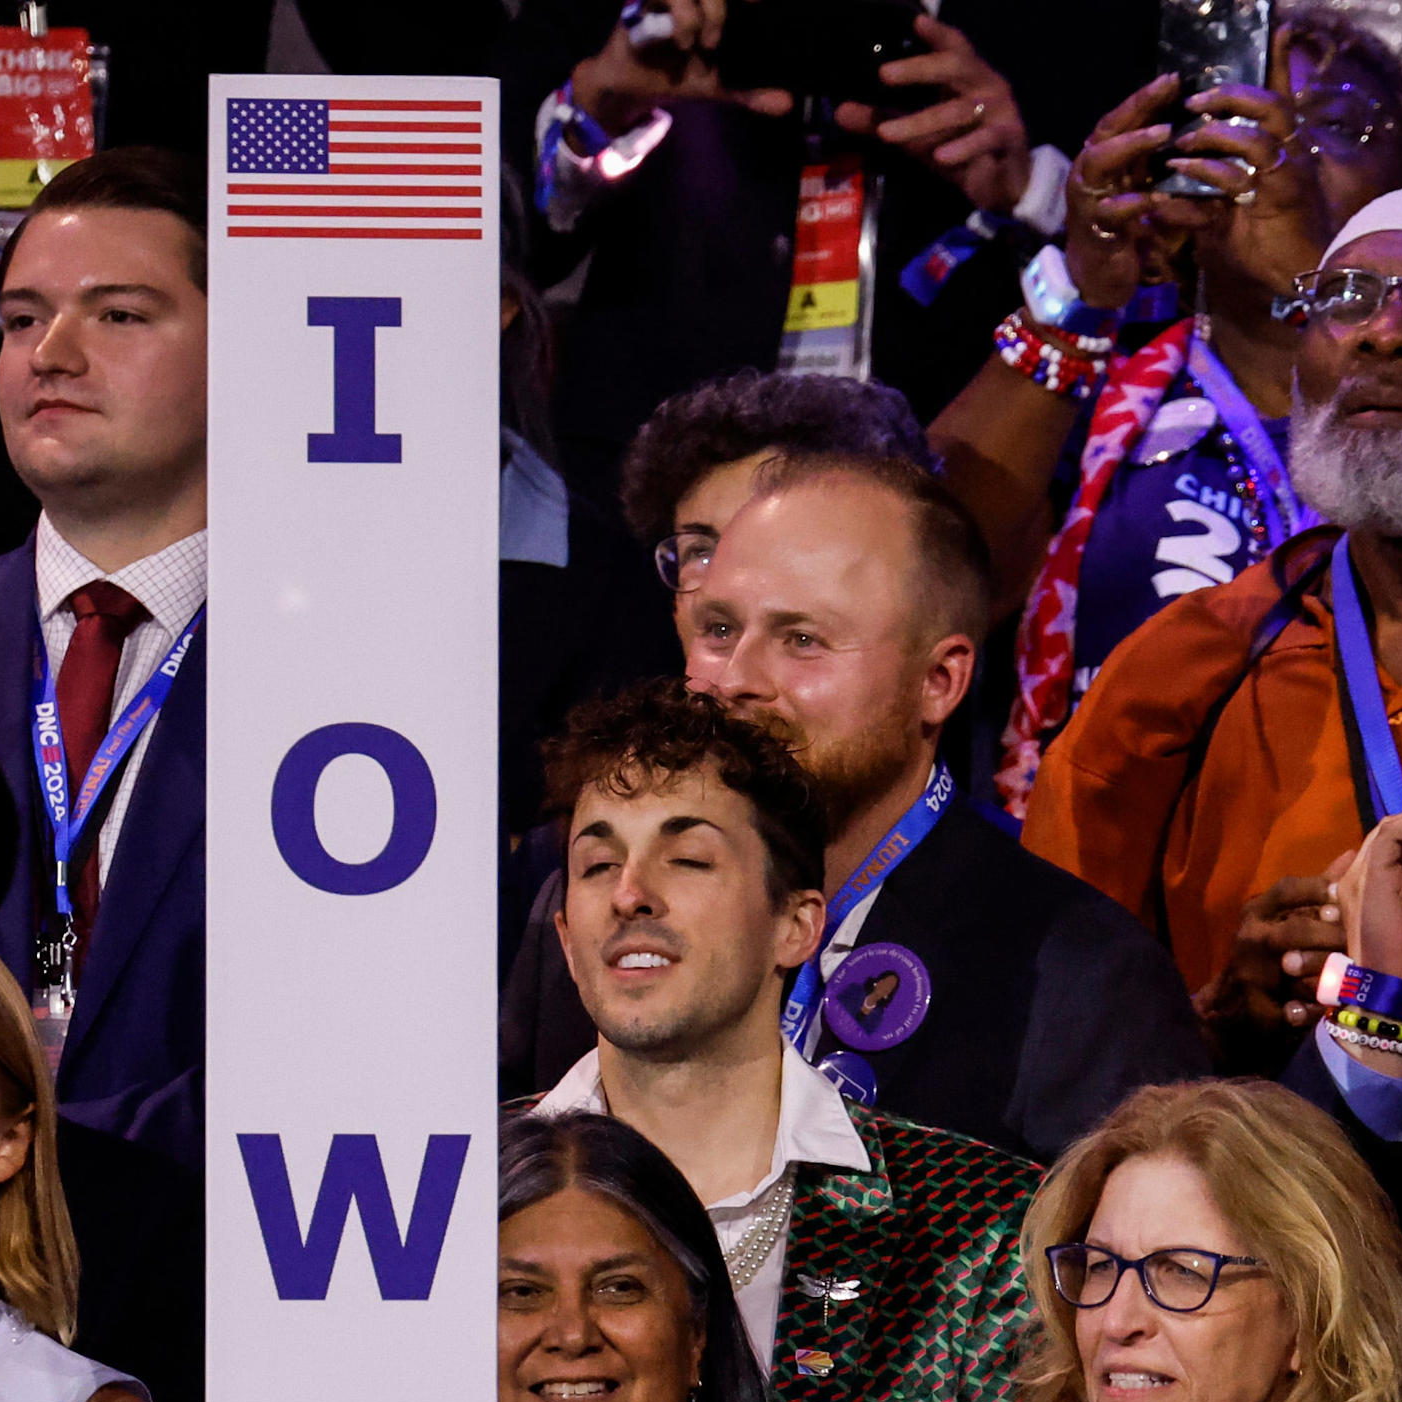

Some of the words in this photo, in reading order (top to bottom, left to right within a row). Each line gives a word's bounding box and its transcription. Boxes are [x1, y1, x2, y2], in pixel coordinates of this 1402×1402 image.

[35, 702, 59, 746] DNC
[44, 762, 65, 821] 2024
[850, 832, 910, 892] LIUNA!
